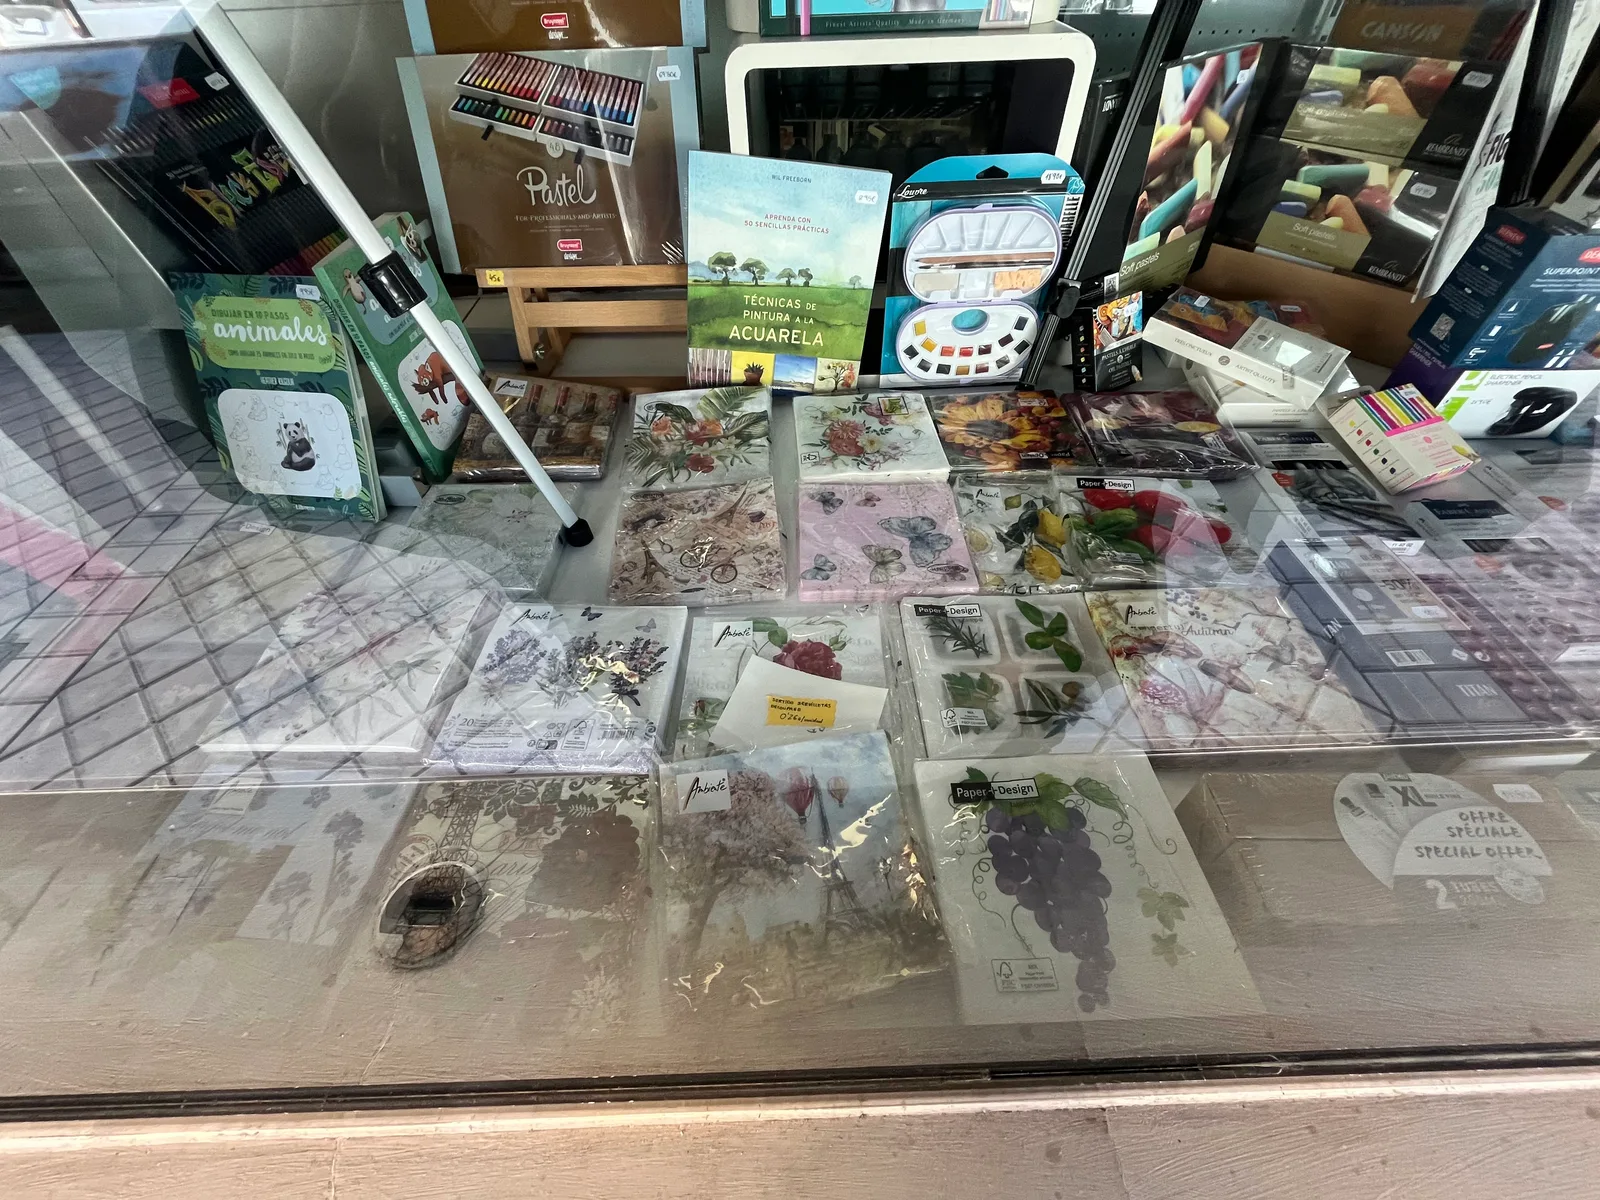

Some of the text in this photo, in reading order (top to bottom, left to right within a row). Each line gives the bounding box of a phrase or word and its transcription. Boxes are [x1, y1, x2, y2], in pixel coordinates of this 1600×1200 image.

[937, 16, 965, 25] Germany
[1360, 20, 1445, 43] CANSON
[1425, 143, 1472, 156] REMBRANDT
[516, 164, 597, 207] Pastel
[782, 175, 812, 184] FREEBORN
[897, 185, 928, 199] Louvre
[765, 213, 811, 224] APRENDA CON
[755, 220, 791, 230] SENCILLAS
[793, 223, 830, 234] PRÁCTICAS
[1292, 222, 1309, 234] Soft
[1308, 226, 1337, 242] pastels
[1120, 252, 1160, 277] Soft pastels
[1543, 267, 1600, 276] SUPERPOINT
[1367, 265, 1406, 283] REMBRANDT
[743, 293, 817, 311] TÉCNICAS DE
[211, 308, 290, 320] DIBUJAR EN 10 PASOS
[743, 310, 790, 322] PINTURA
[803, 316, 814, 325] LA
[213, 316, 328, 346] animales
[728, 325, 824, 346] ACUARELA
[358, 339, 372, 360] PASOS
[1456, 683, 1498, 697] TITAN
[459, 717, 475, 727] 20
[1389, 785, 1439, 807] XL
[1458, 810, 1510, 824] OFFRE
[1446, 823, 1523, 838] SPÉCIALE
[1414, 845, 1543, 860] SPECIAL OFFER
